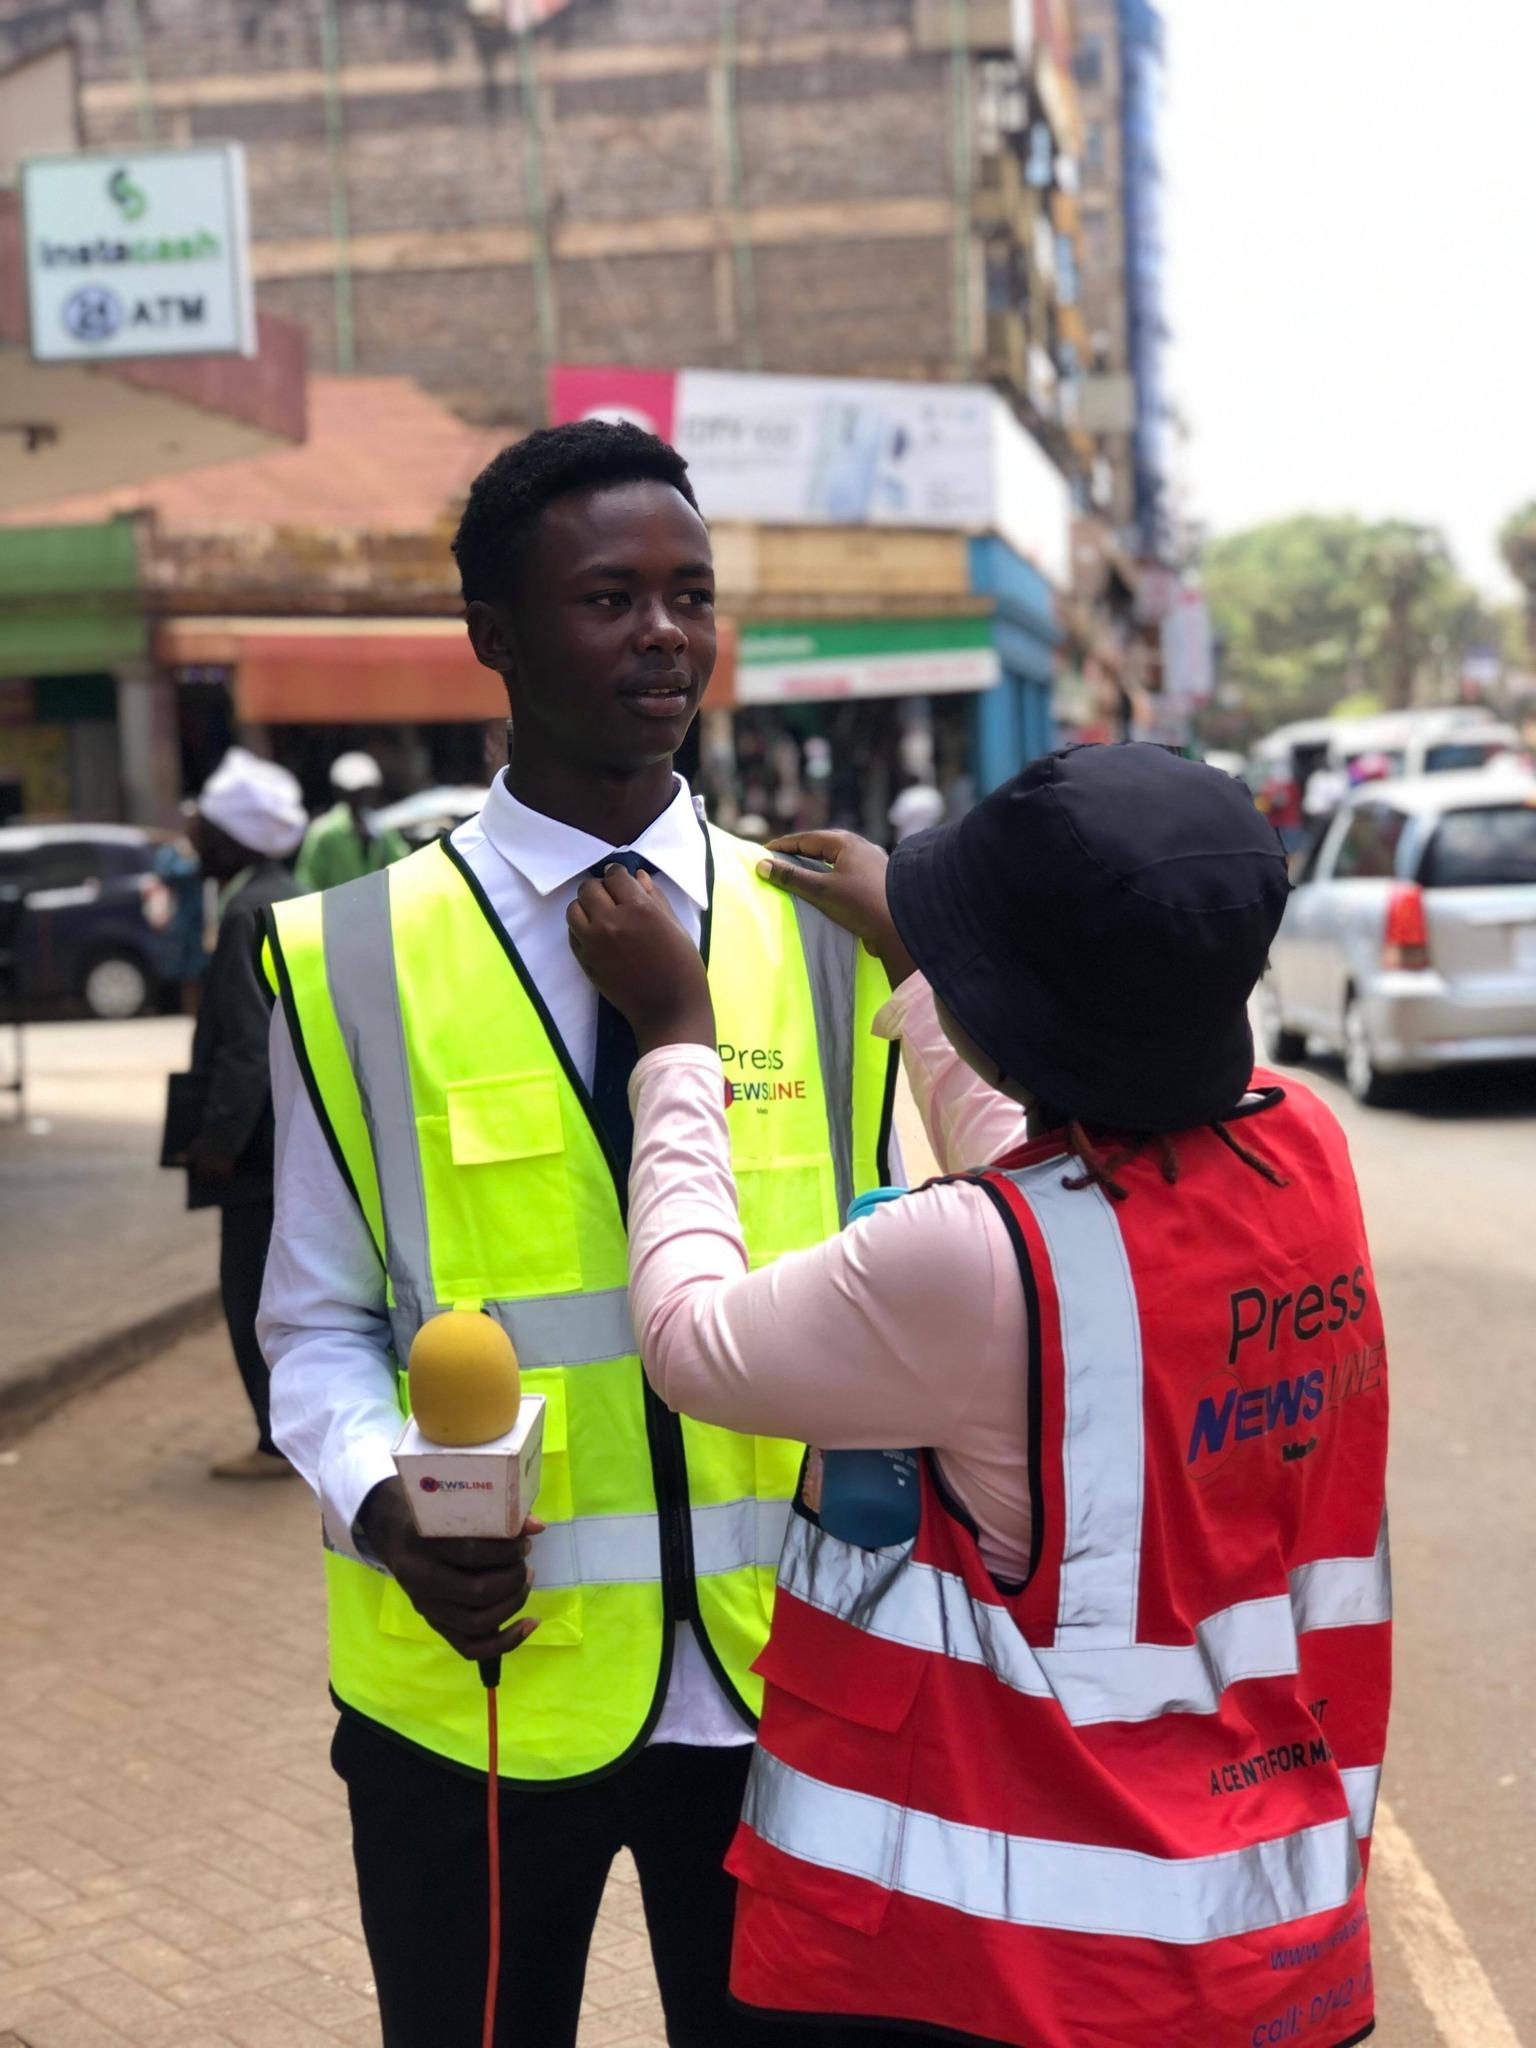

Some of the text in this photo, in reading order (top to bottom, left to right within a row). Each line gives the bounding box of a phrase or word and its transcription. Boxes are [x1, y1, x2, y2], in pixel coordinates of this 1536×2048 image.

[132, 293, 205, 326] ATM
[724, 1080, 806, 1101] EWSLINE
[1228, 1265, 1367, 1364] Press
